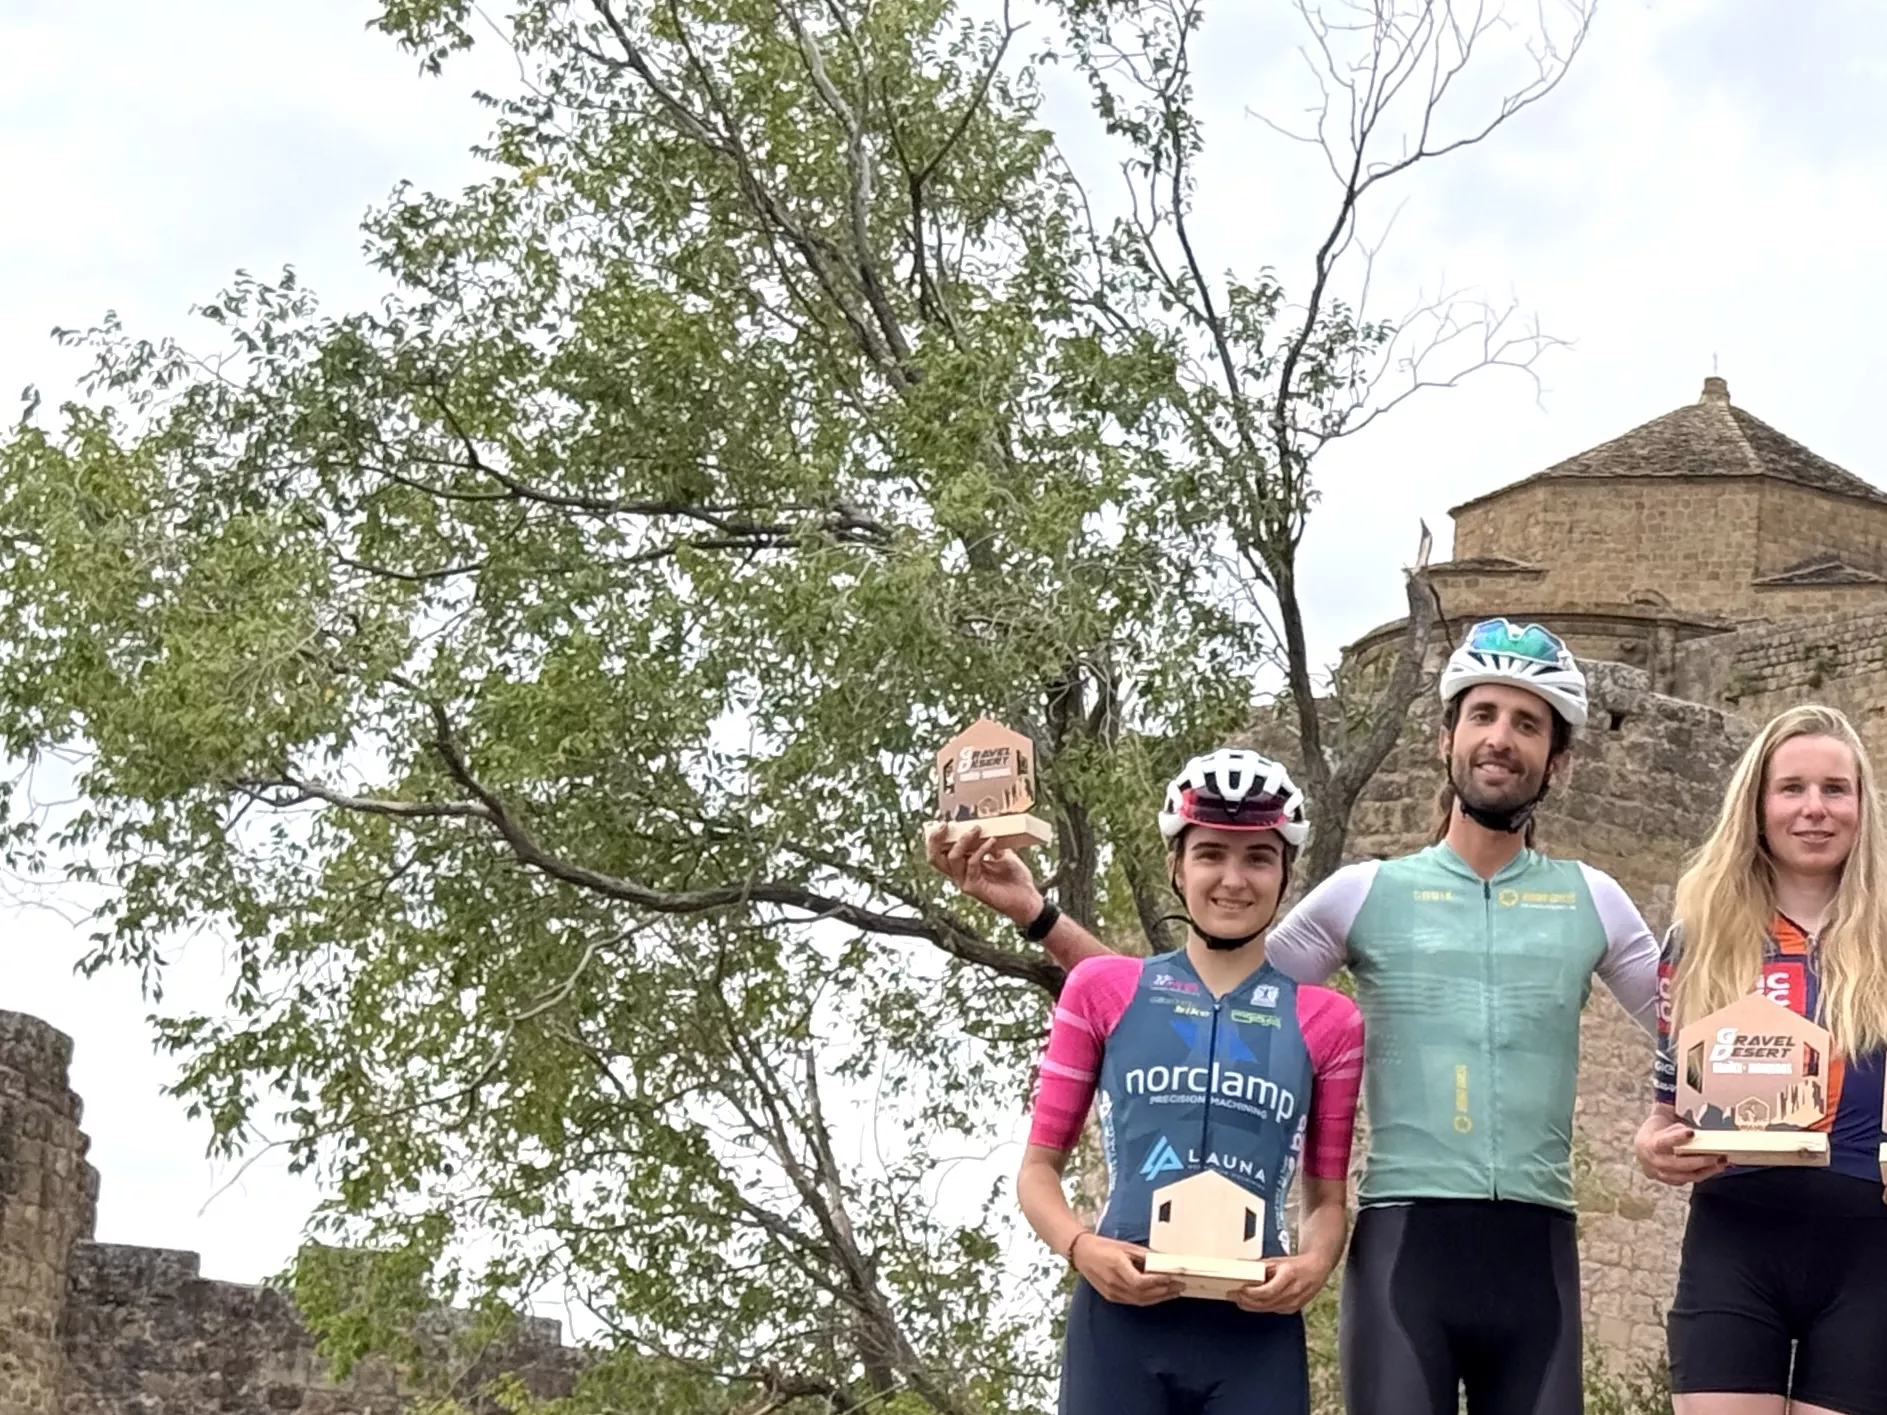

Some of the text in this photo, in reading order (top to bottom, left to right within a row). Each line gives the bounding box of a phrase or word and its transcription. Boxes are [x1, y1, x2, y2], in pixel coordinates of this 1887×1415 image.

[1717, 1027, 1797, 1047] GRAVEL
[1709, 1044, 1793, 1062] DESERT
[1126, 1061, 1295, 1124] norclamp
[1188, 1148, 1267, 1185] LAUNA
